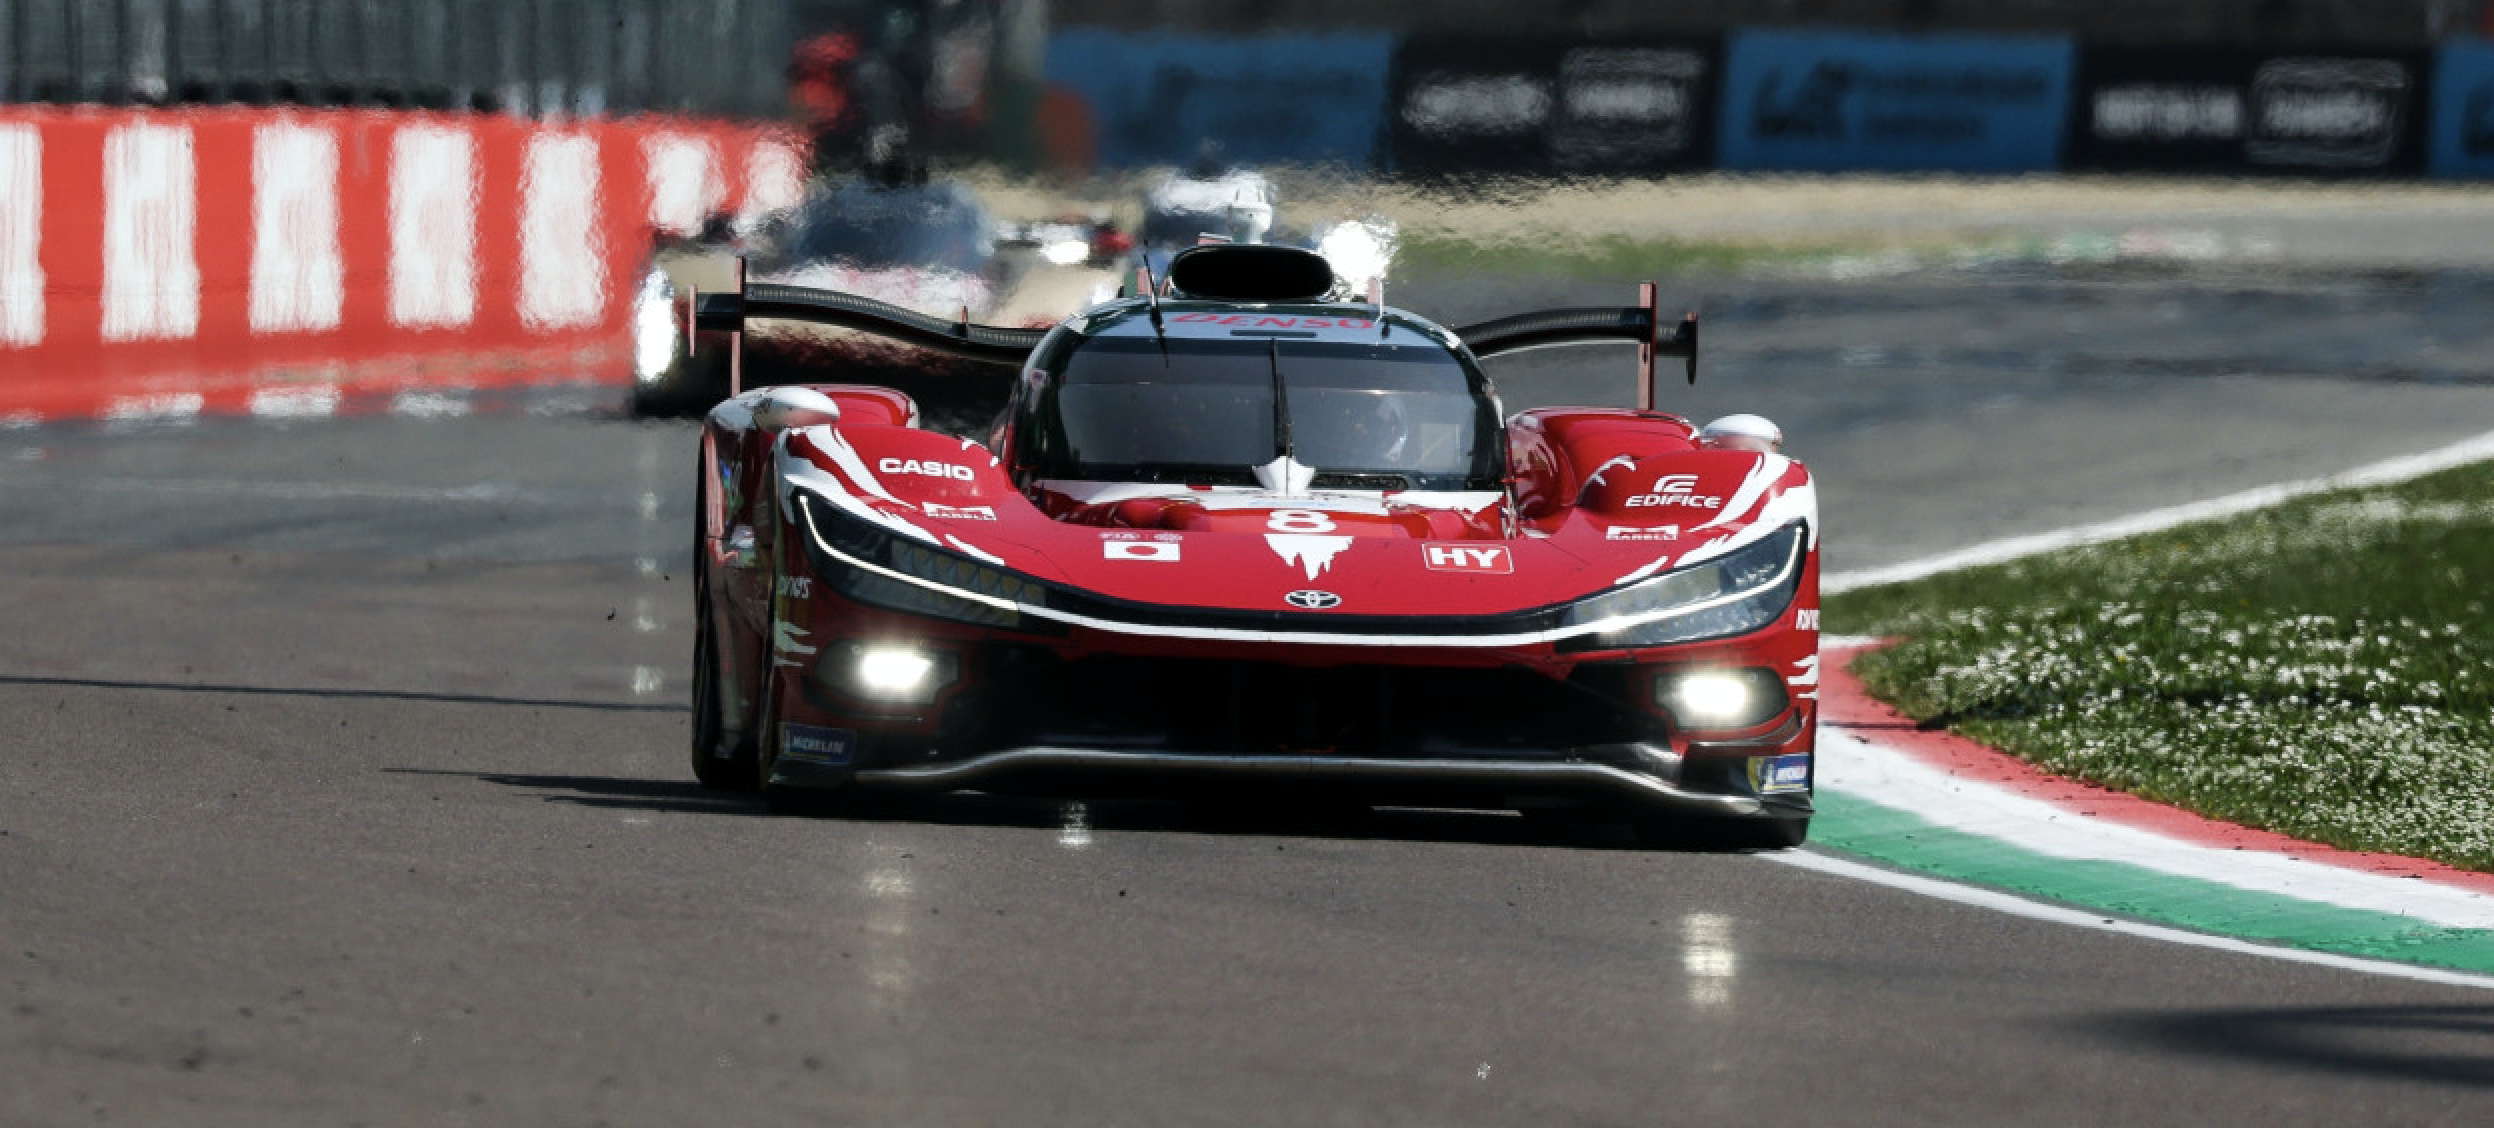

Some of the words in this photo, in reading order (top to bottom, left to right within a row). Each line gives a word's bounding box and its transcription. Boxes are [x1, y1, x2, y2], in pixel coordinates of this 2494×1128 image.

[1170, 313, 1373, 329] DENSO
[879, 458, 974, 481] CASIO
[1625, 493, 1721, 509] EDIFICE
[1266, 509, 1337, 532] 8
[1429, 547, 1501, 568] HY
